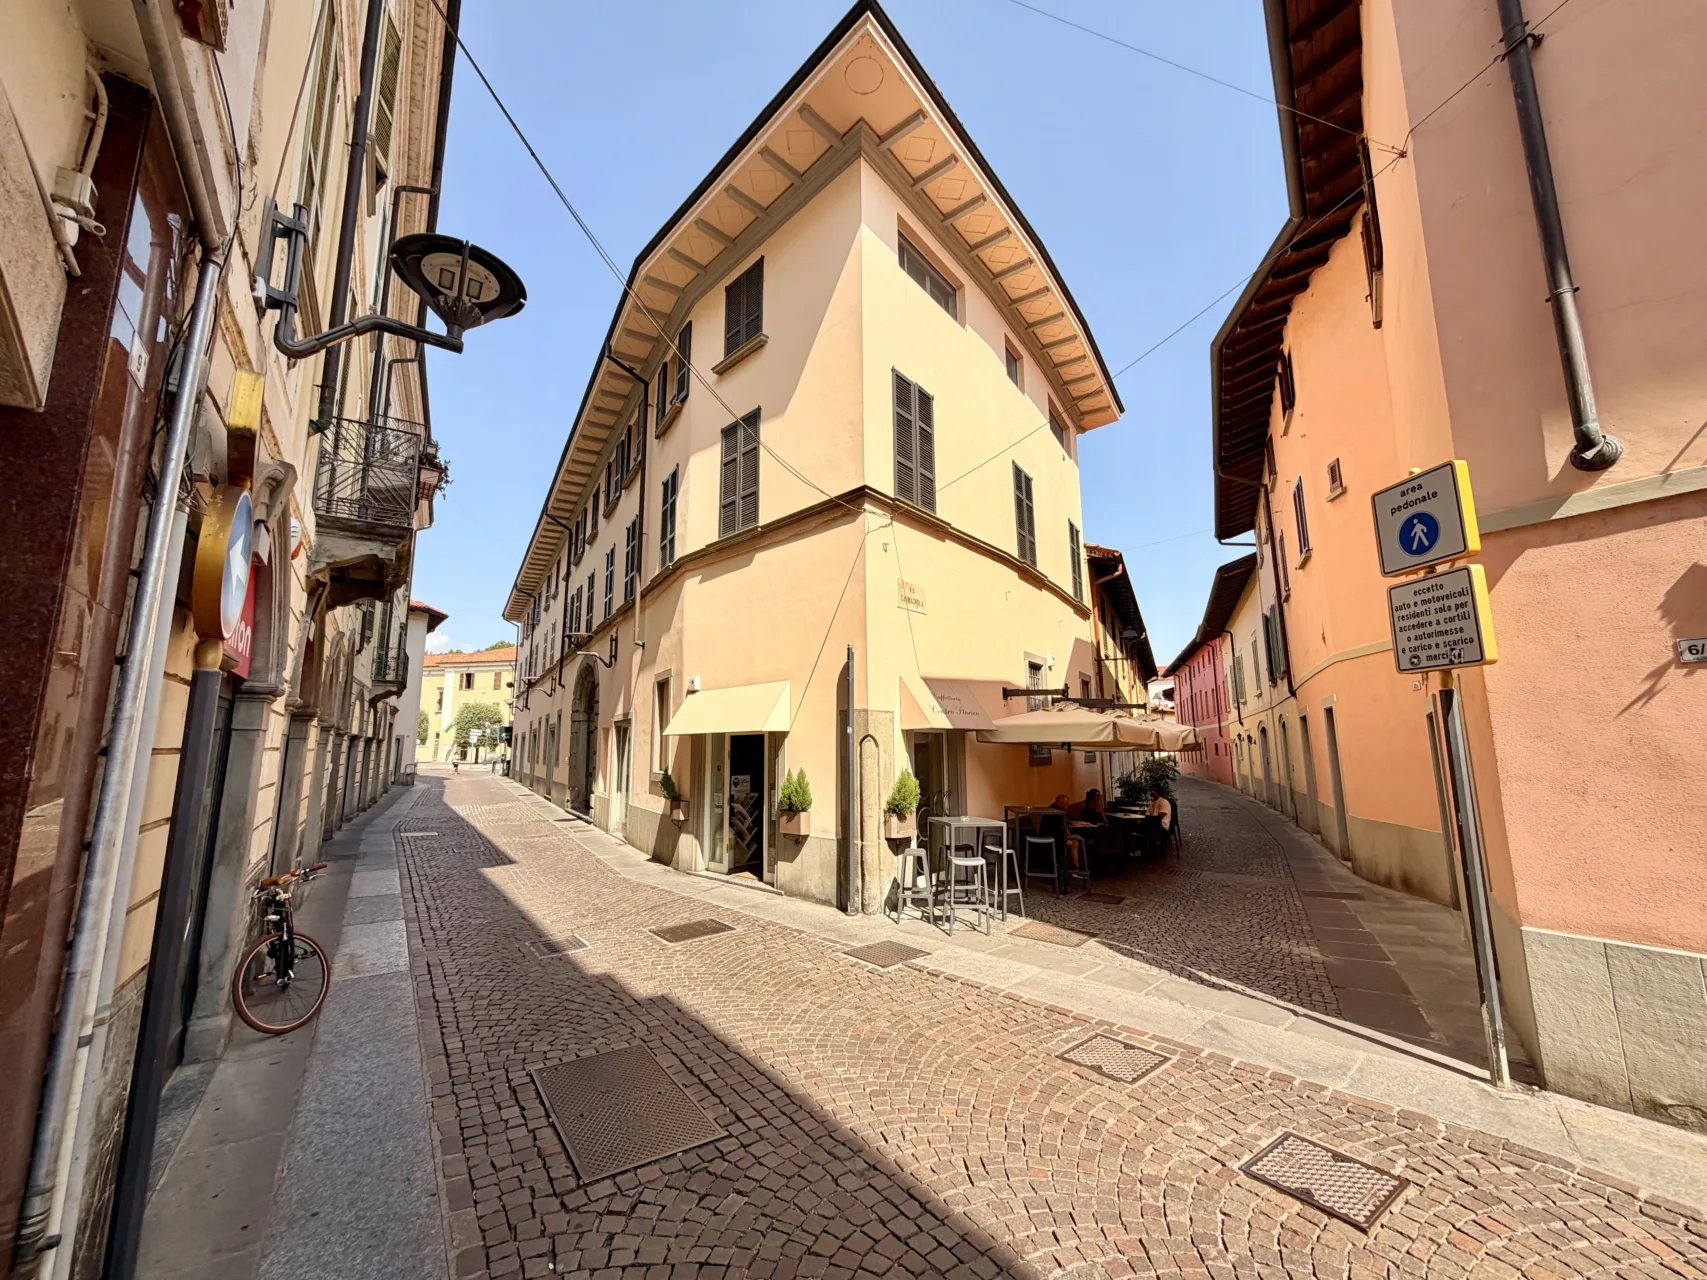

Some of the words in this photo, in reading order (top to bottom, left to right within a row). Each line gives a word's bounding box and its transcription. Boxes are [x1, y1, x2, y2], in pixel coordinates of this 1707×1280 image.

[1400, 483, 1423, 498] area
[1390, 491, 1438, 517] pedonale
[1413, 583, 1444, 596] eccetto
[1394, 602, 1411, 612] auto
[1421, 587, 1469, 606] motoveicoli
[1397, 607, 1431, 622] residenti
[1434, 603, 1452, 615] solo
[1454, 601, 1468, 612] per
[1399, 620, 1433, 632] accedere
[1443, 611, 1471, 624] cortili
[1414, 626, 1464, 641] autorimesse
[1408, 643, 1432, 653] carico
[1443, 636, 1474, 648] scarico
[1426, 650, 1449, 662] merci
